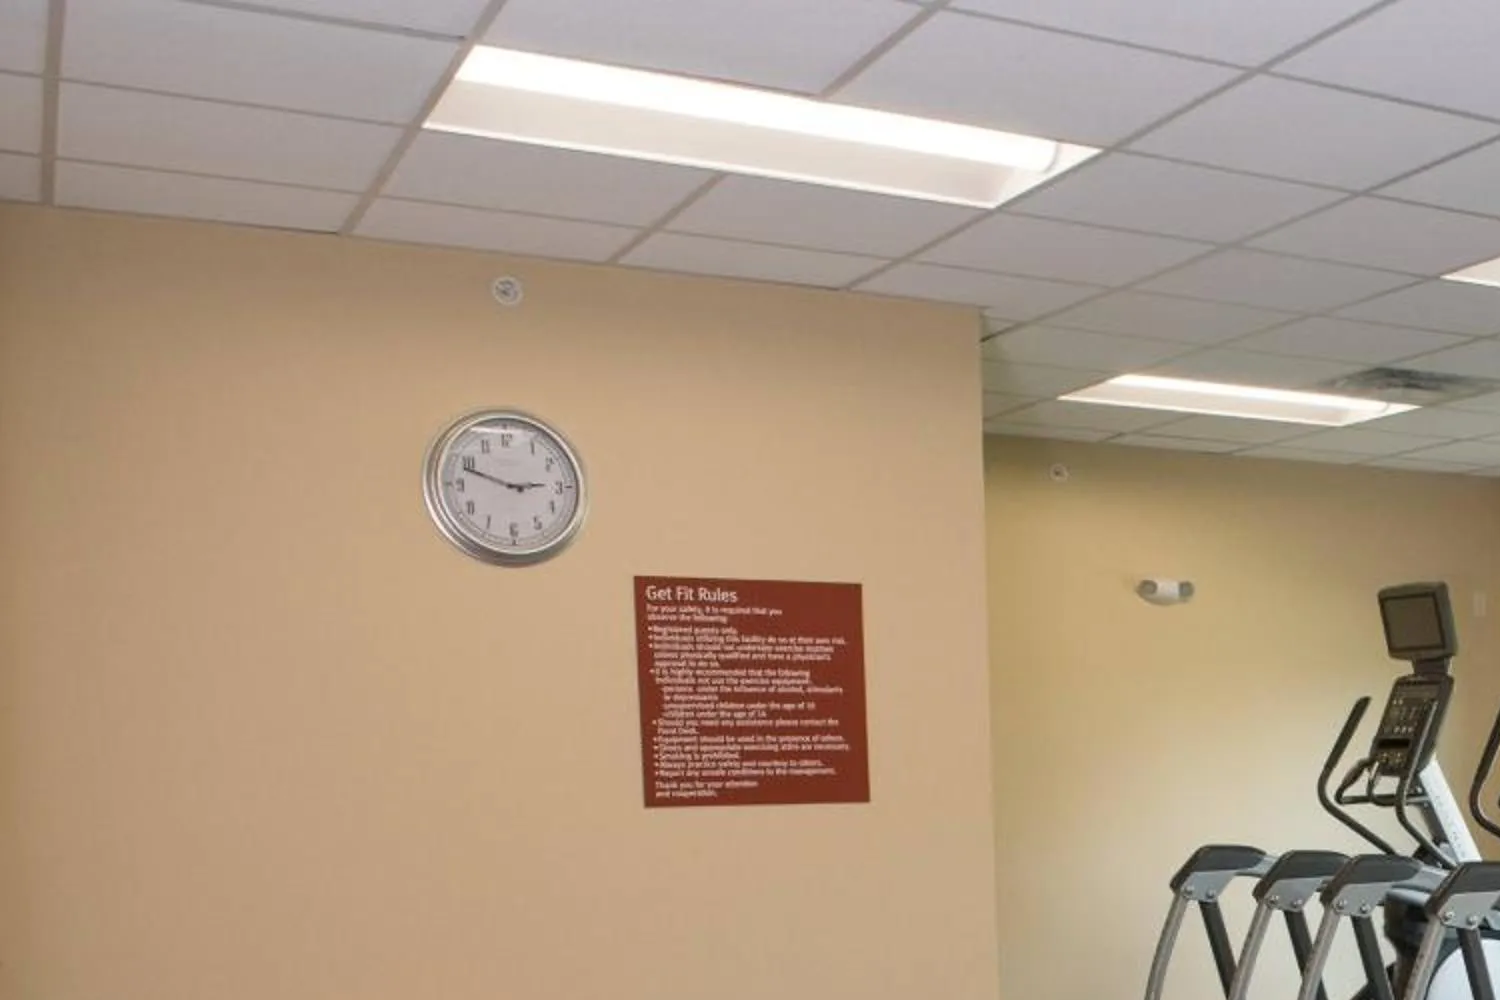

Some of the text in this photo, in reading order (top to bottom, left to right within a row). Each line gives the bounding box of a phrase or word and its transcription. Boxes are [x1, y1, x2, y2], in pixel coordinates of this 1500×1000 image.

[645, 585, 738, 603] Get Fit Rules
